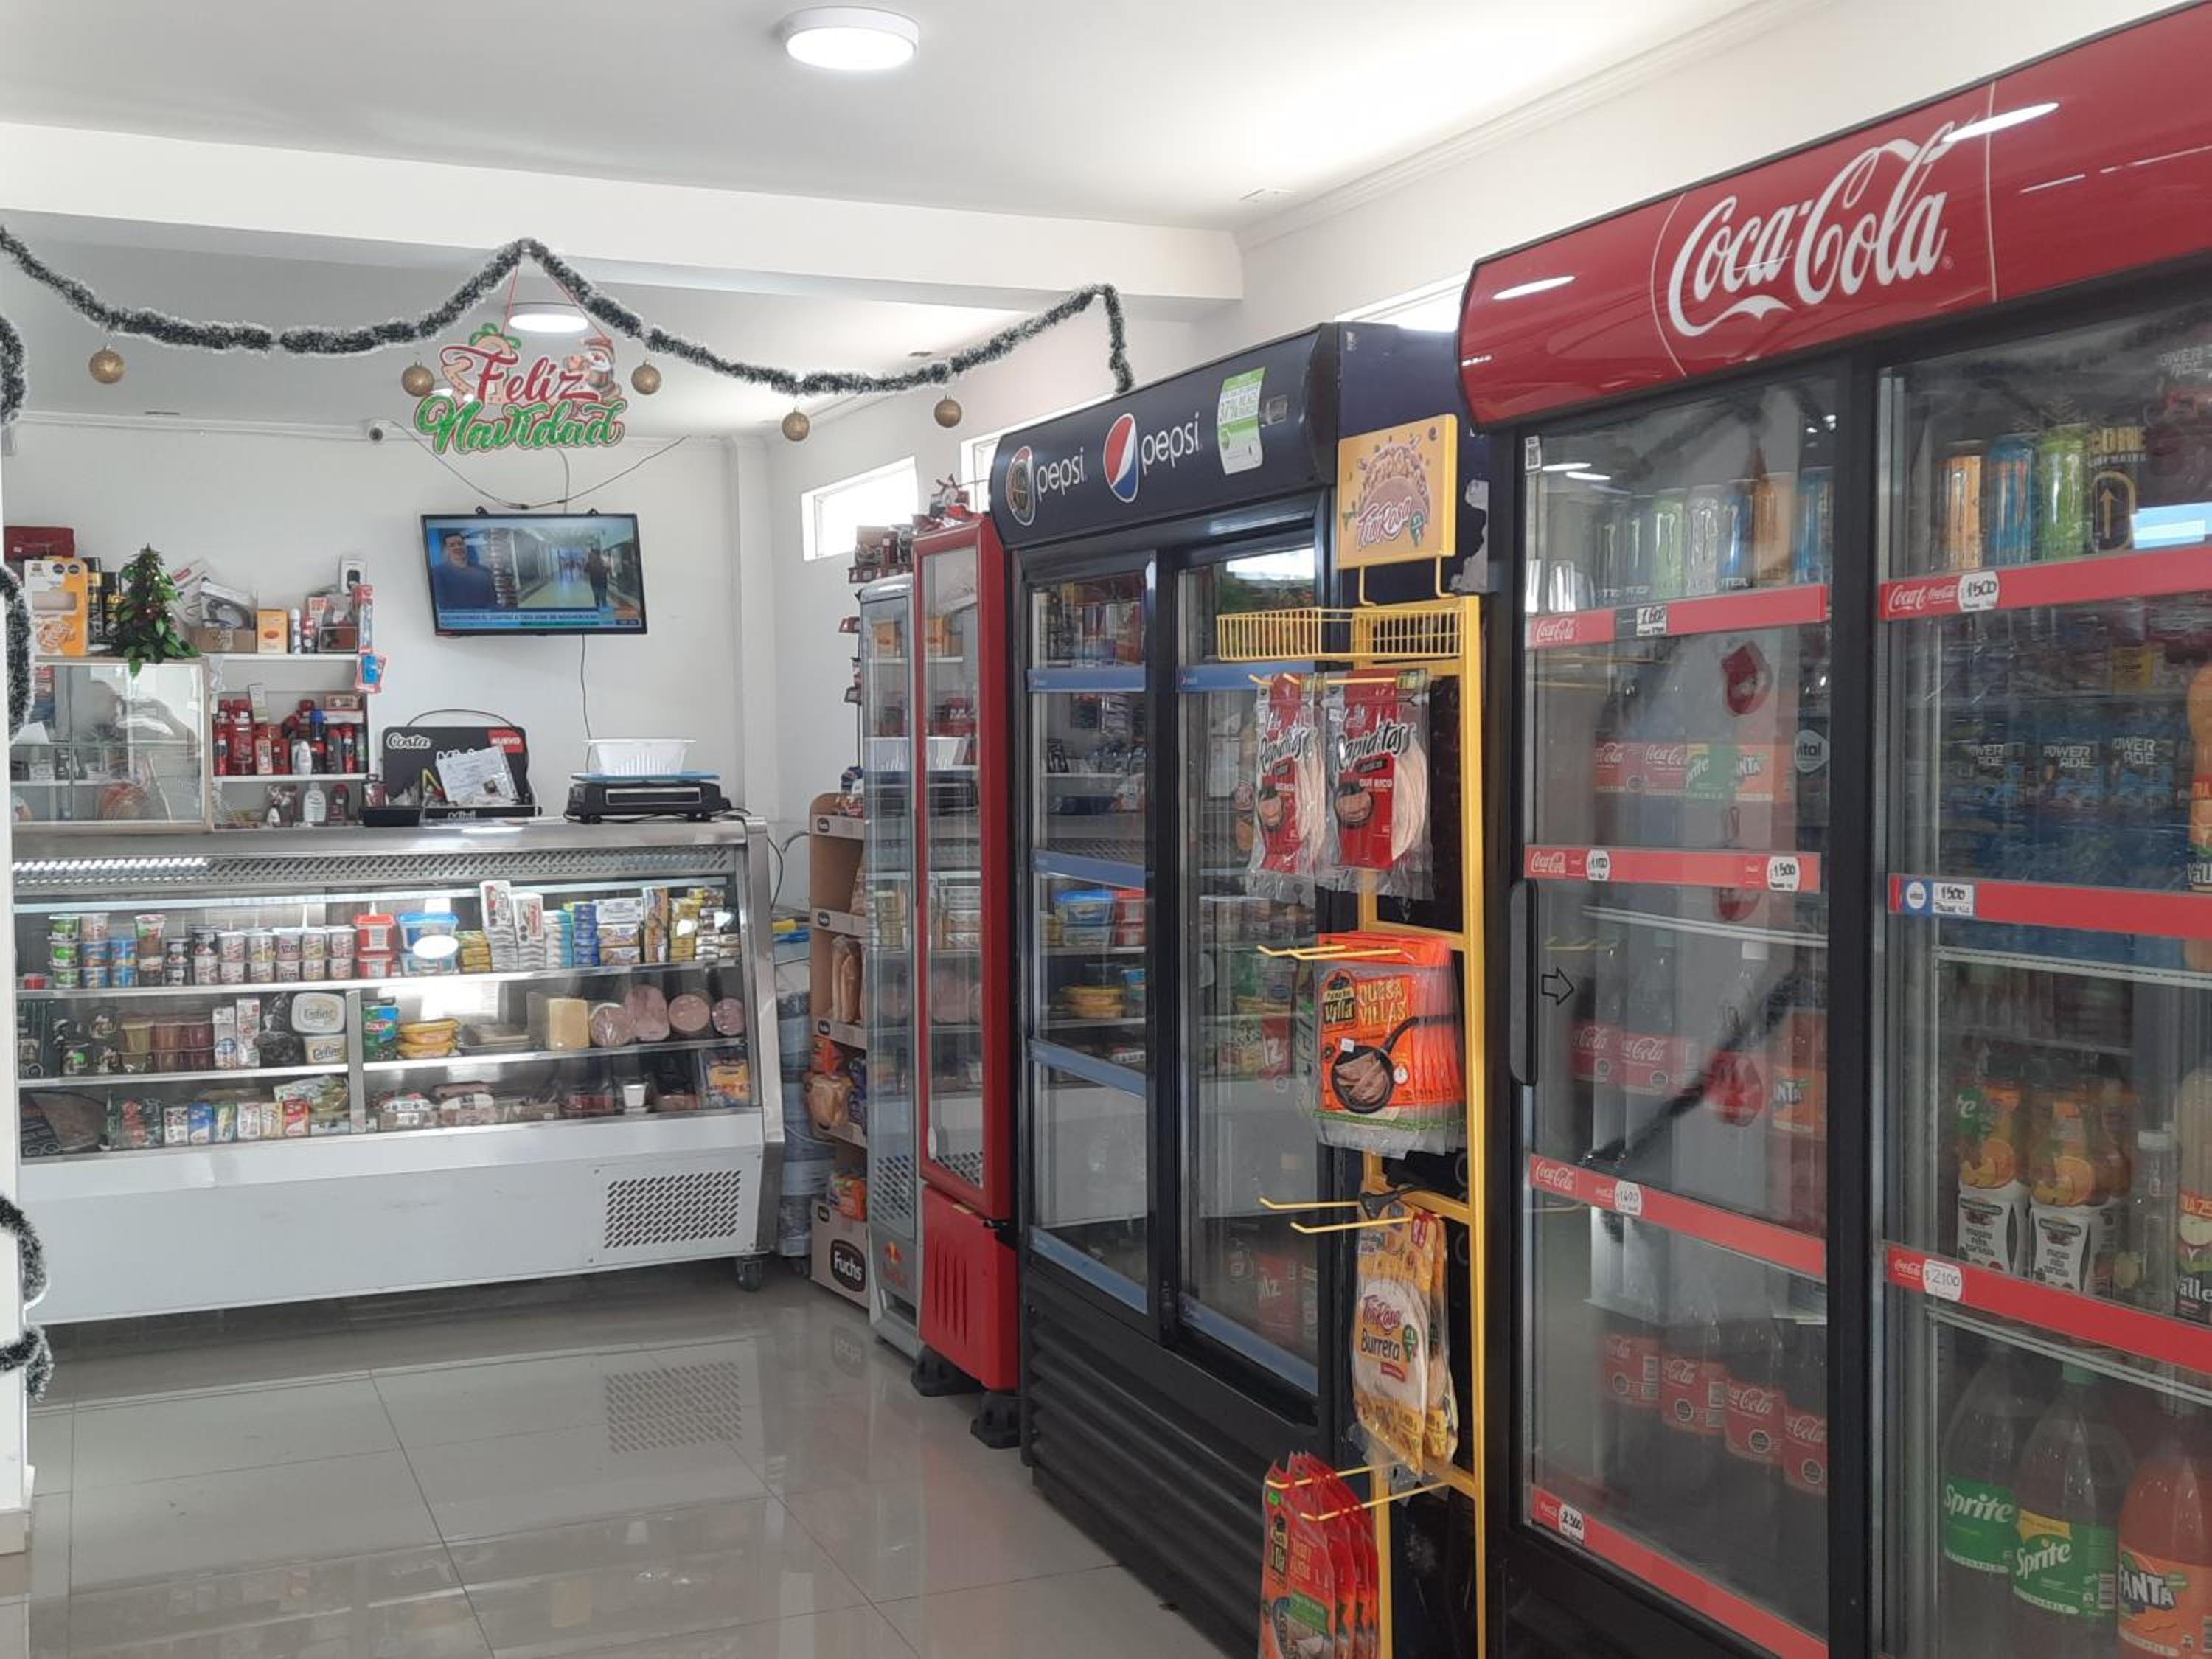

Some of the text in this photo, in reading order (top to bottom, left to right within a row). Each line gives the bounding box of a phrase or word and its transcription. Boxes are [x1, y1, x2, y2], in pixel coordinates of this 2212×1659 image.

[1669, 120, 1961, 336] Coca-Cola
[440, 344, 599, 403] Feliz
[415, 395, 627, 454] Navidad
[1141, 412, 1200, 474] pepsi
[1036, 447, 1085, 501] pepsi
[1536, 618, 1576, 643] CocaCola
[387, 733, 431, 749] Costa
[1334, 718, 1408, 773] Rapiditas
[1531, 851, 1566, 874] CocaCola
[1357, 978, 1404, 1004] QUESA
[1325, 1000, 1354, 1024] Villa
[1359, 1001, 1407, 1026] VILLAS
[1535, 1161, 1574, 1192] CocaCola
[834, 1251, 862, 1281] Fuchs
[1361, 1327, 1401, 1362] Burrera
[1944, 1484, 2013, 1523] Sprite
[2015, 1539, 2073, 1580] Sprite
